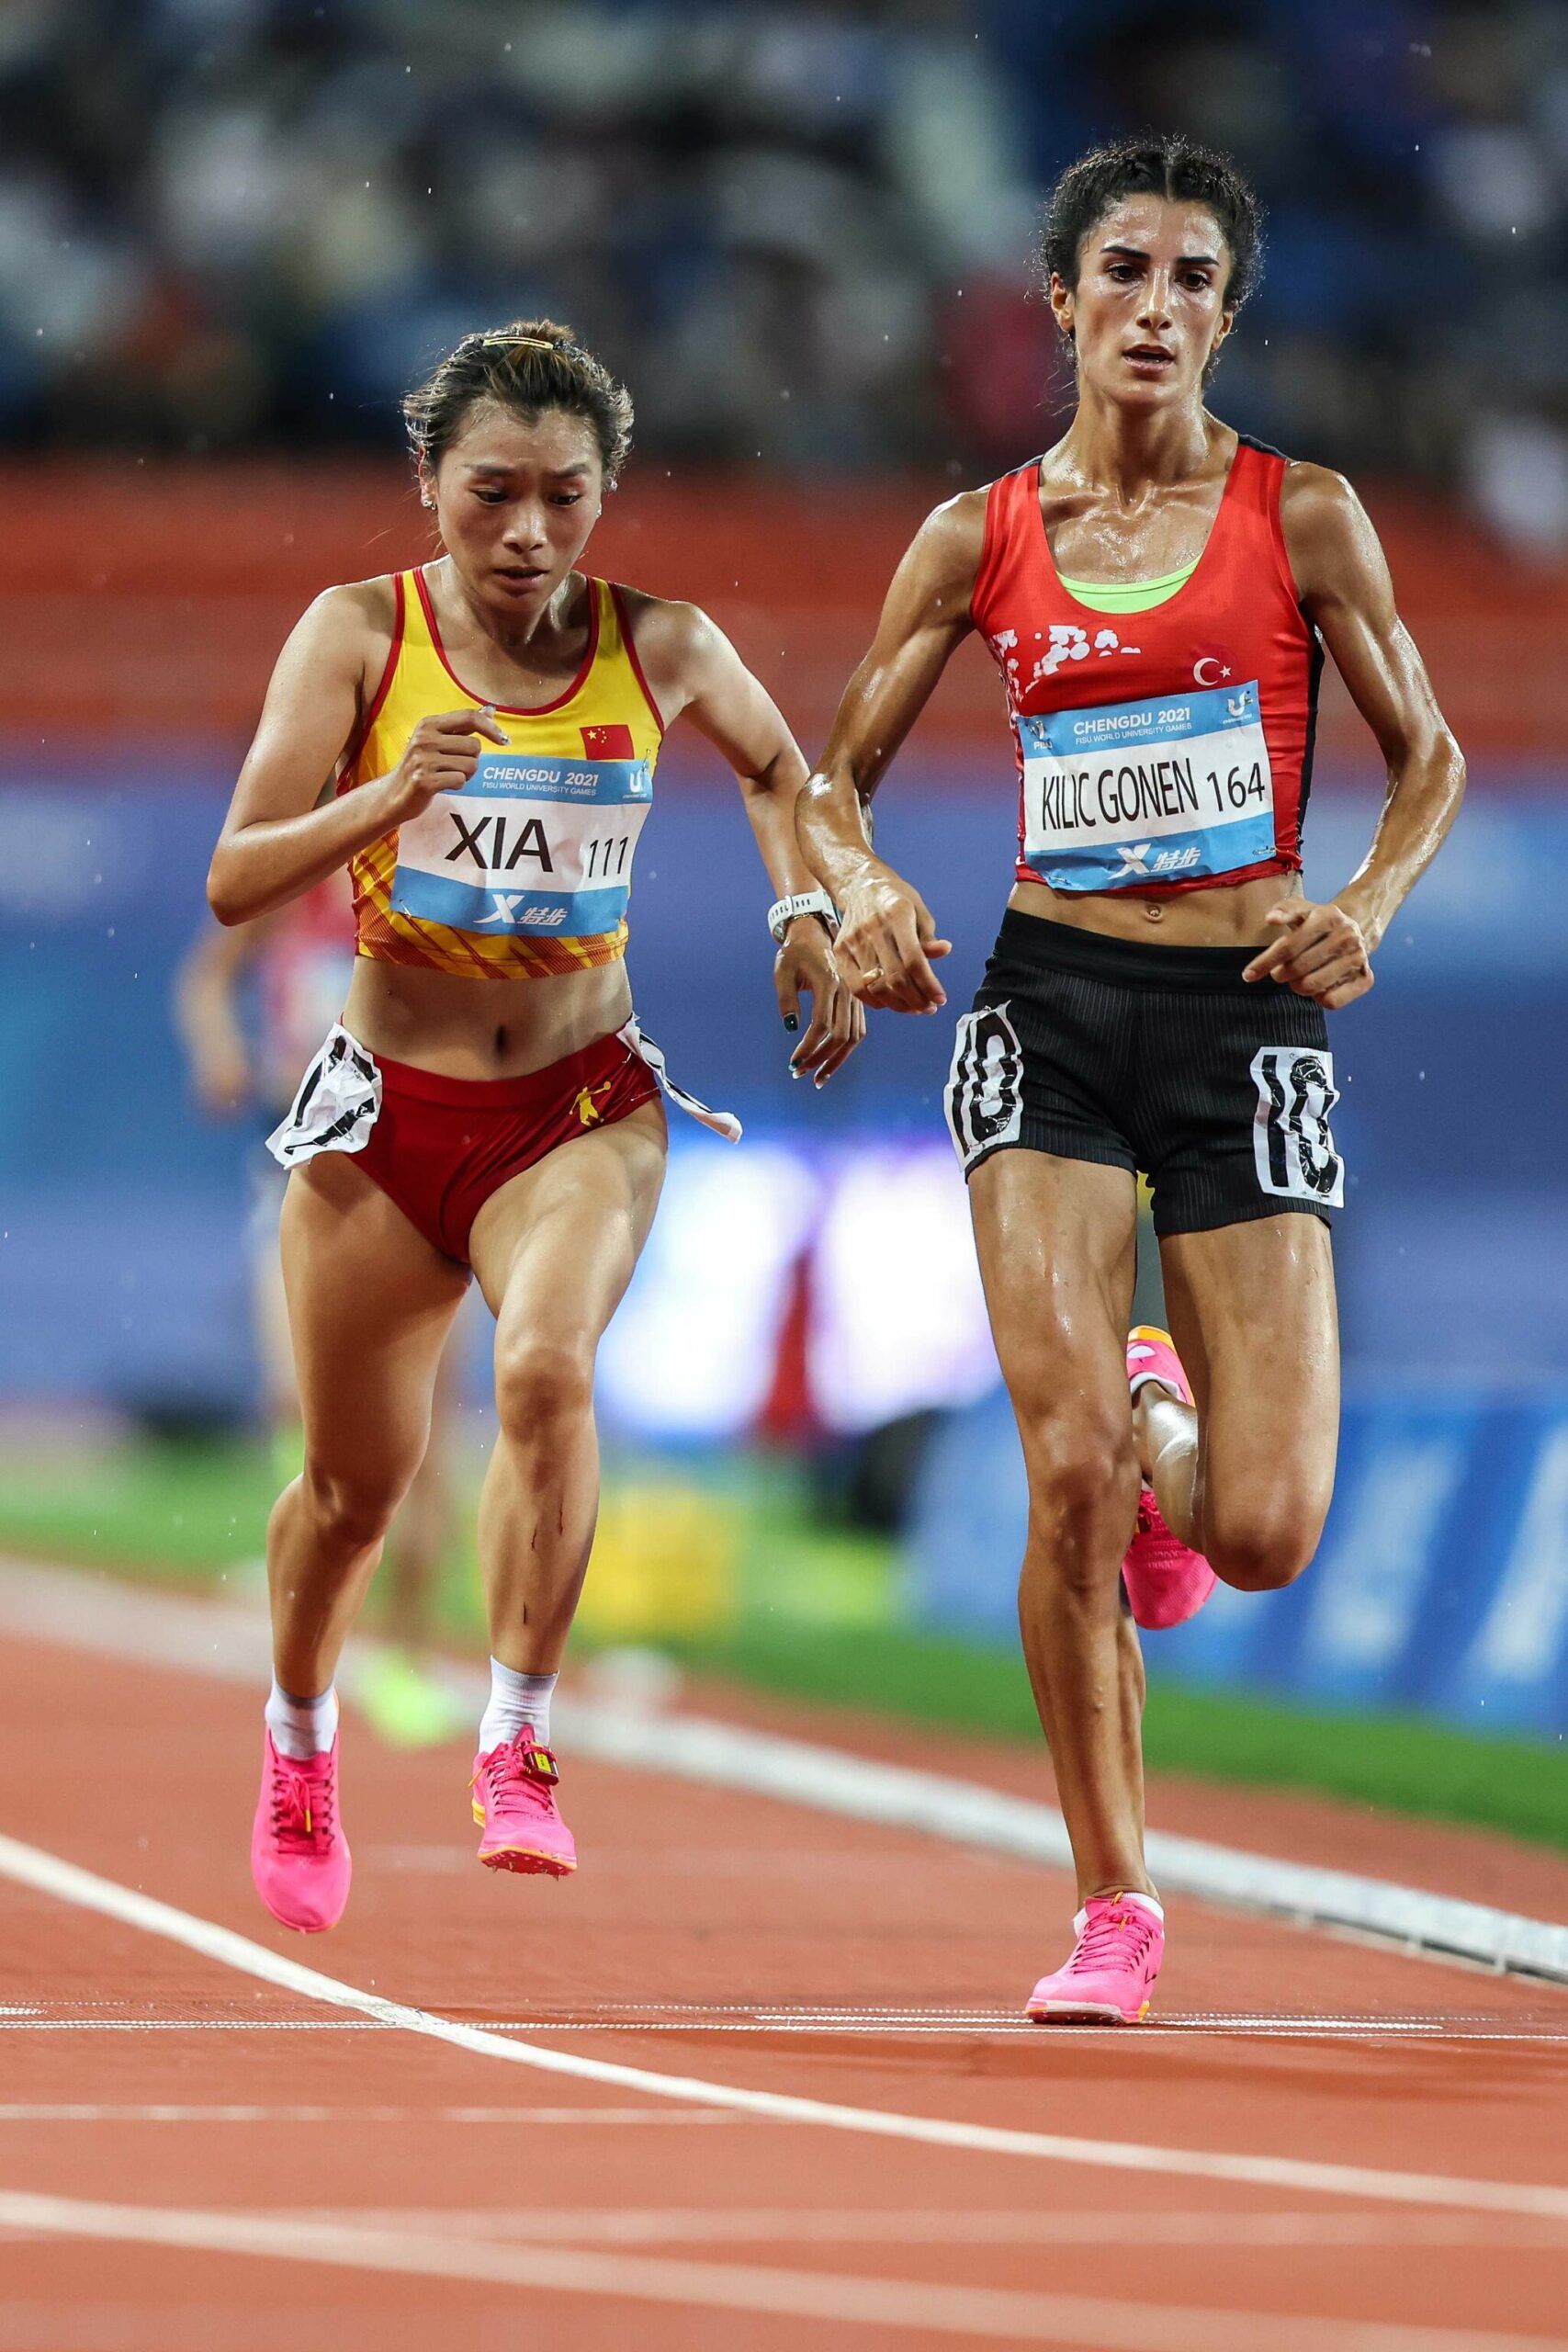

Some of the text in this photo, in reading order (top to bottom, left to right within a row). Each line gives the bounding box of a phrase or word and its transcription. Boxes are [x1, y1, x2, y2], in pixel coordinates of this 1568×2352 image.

[1073, 707, 1190, 735] CHENGDU 2021
[1075, 722, 1192, 745] FISU WORLD UNIVERSITY GAMES
[482, 781, 596, 797] FISU WORLD UNIVERSITY GAMES
[483, 766, 599, 786] CHENGDU 2021
[1043, 758, 1265, 831] KILIC GONEN 164
[445, 812, 629, 878] XIA 111
[952, 1010, 1018, 1158] 10
[1262, 1054, 1339, 1193] 10
